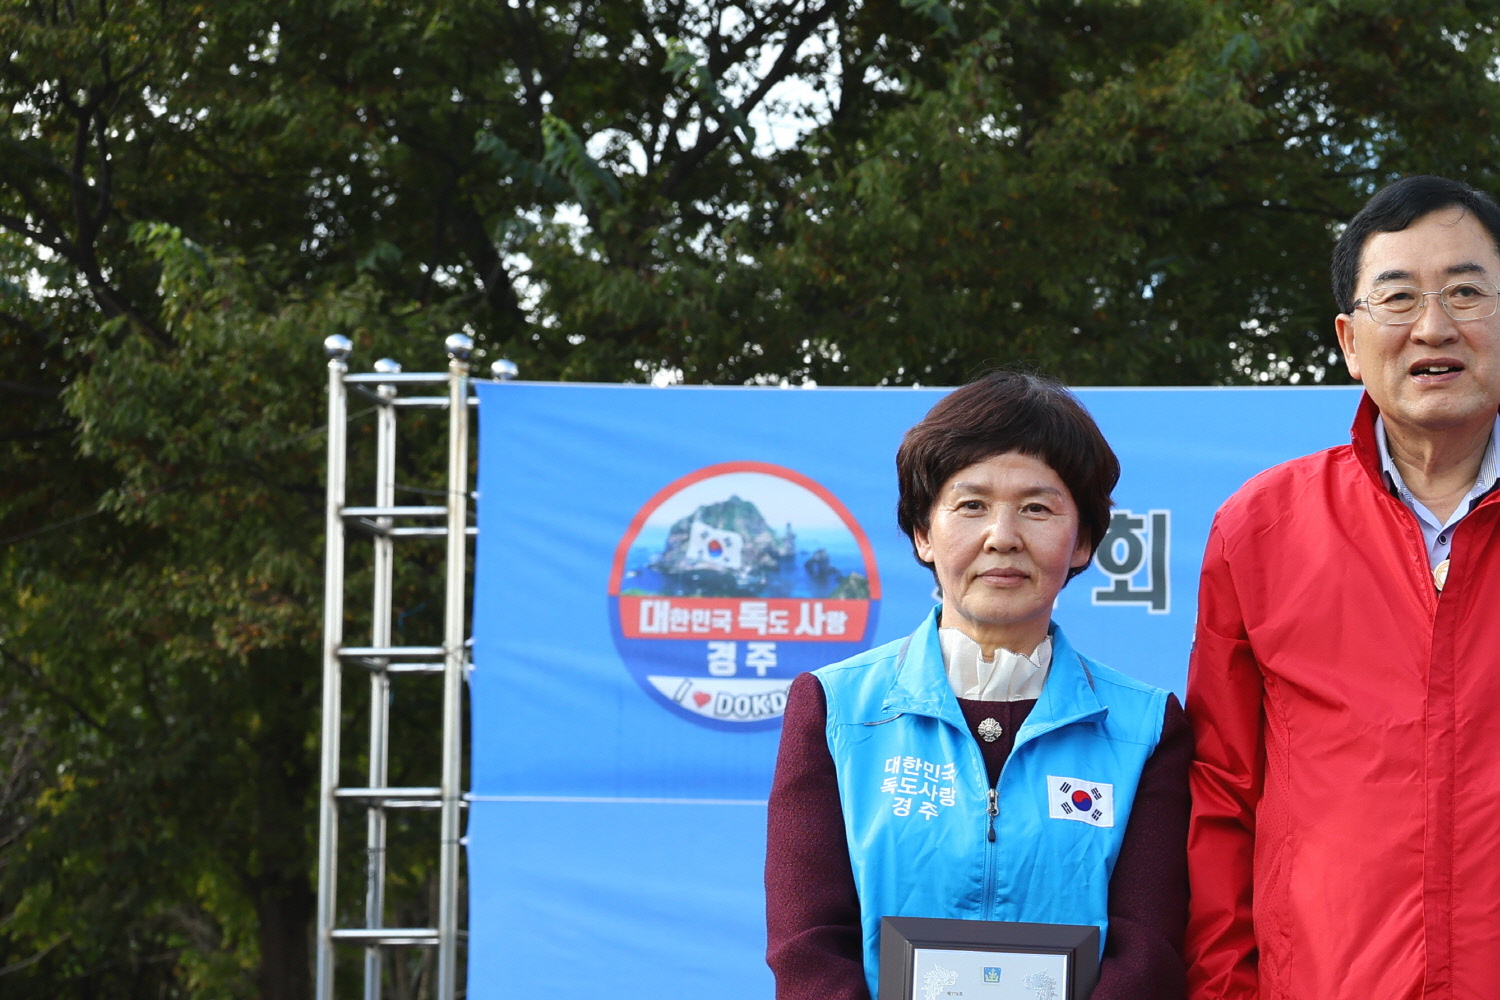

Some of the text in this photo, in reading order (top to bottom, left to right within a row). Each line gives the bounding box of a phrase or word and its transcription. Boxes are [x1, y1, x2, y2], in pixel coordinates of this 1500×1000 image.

[639, 599, 849, 636] 대한민국 독도 사랑
[714, 682, 791, 717] DOKD
[884, 755, 956, 784] 대한민국
[880, 776, 957, 807] 독도사랑
